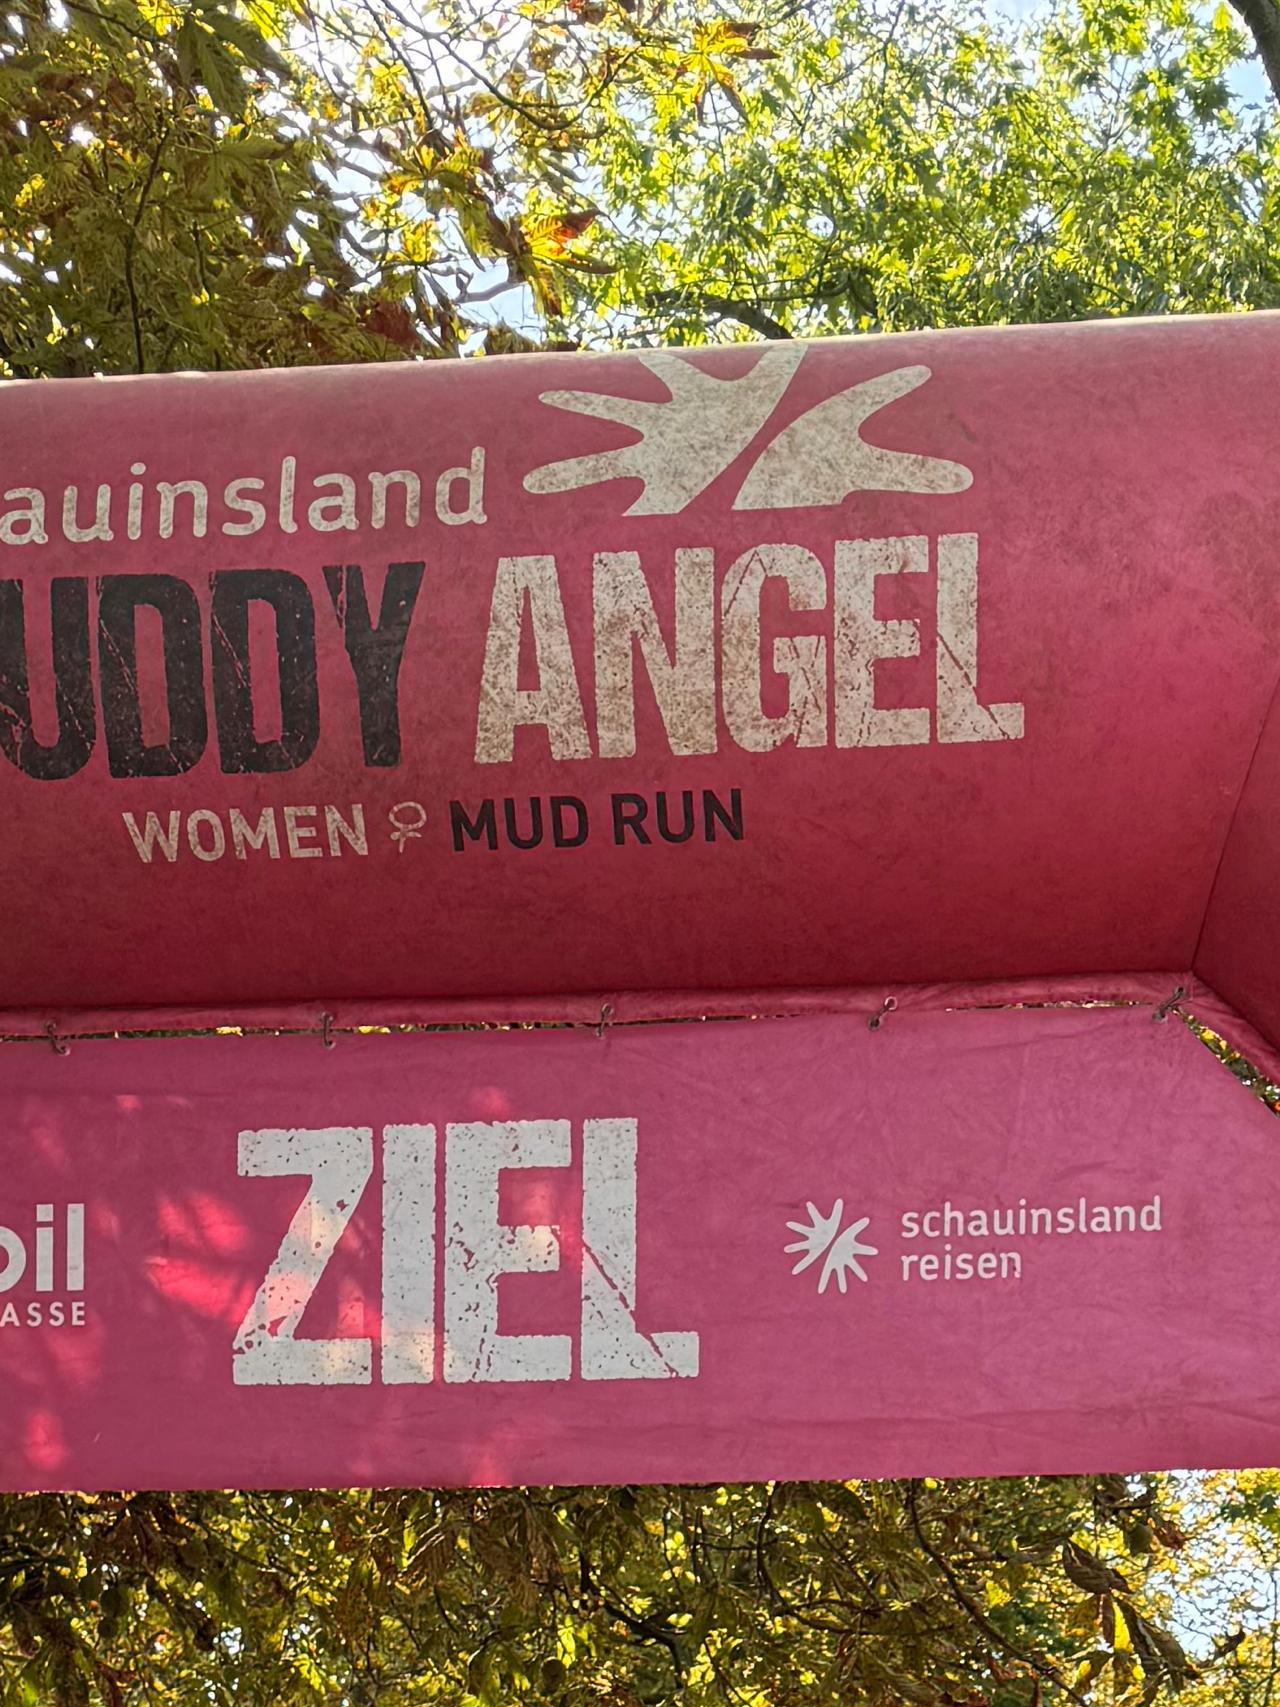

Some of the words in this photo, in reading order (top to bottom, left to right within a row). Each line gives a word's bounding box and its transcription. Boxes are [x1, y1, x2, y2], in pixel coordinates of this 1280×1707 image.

[475, 532, 1025, 765] ANGEL
[122, 801, 370, 864] WOMEN
[451, 794, 590, 851] MUD
[615, 788, 744, 845] RUN
[232, 1118, 699, 1385] ZIEL
[901, 1195, 1161, 1238] schauinsland
[901, 1244, 1021, 1281] reisen
